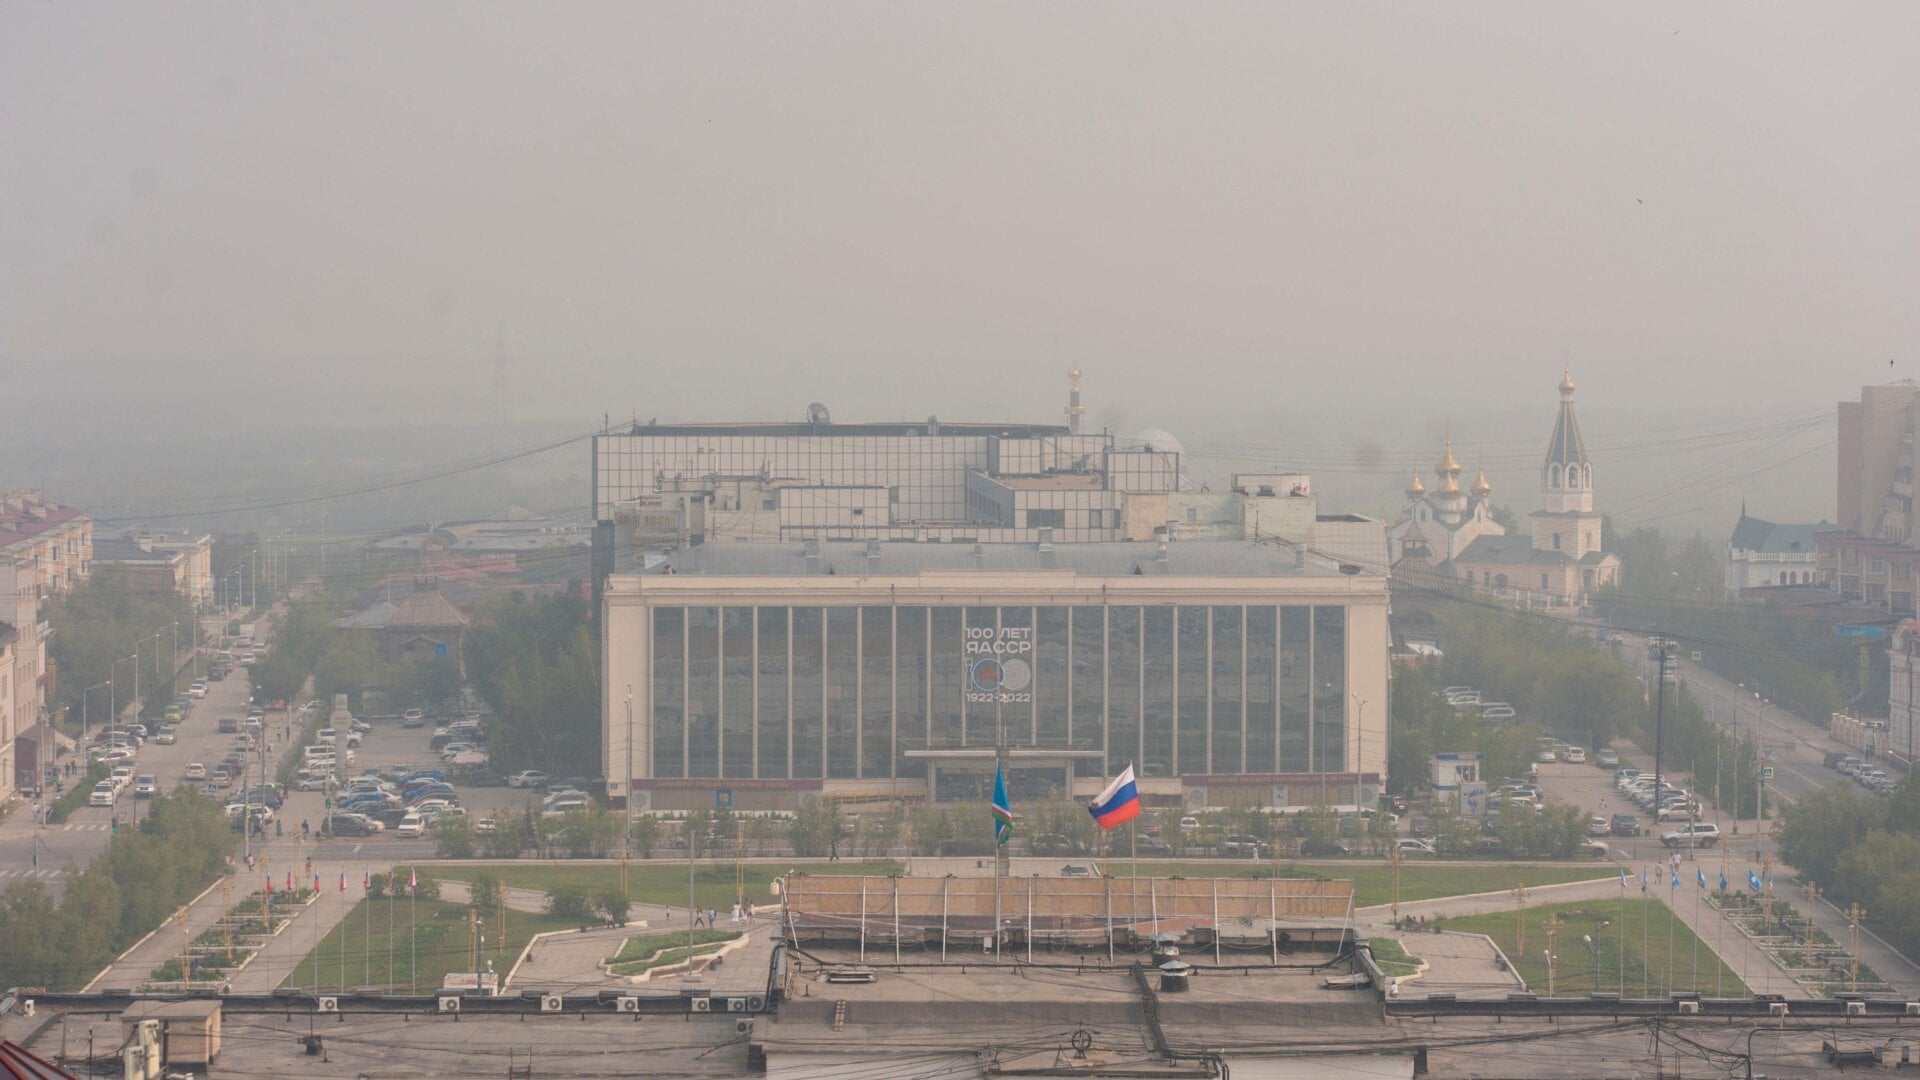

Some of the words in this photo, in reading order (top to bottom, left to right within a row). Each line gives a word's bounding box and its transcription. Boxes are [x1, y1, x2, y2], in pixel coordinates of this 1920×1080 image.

[966, 627, 994, 639] 100
[1000, 627, 1031, 639] ЛЕТ
[966, 640, 1031, 654] ЯАССР
[966, 693, 1031, 703] 1922-2022
